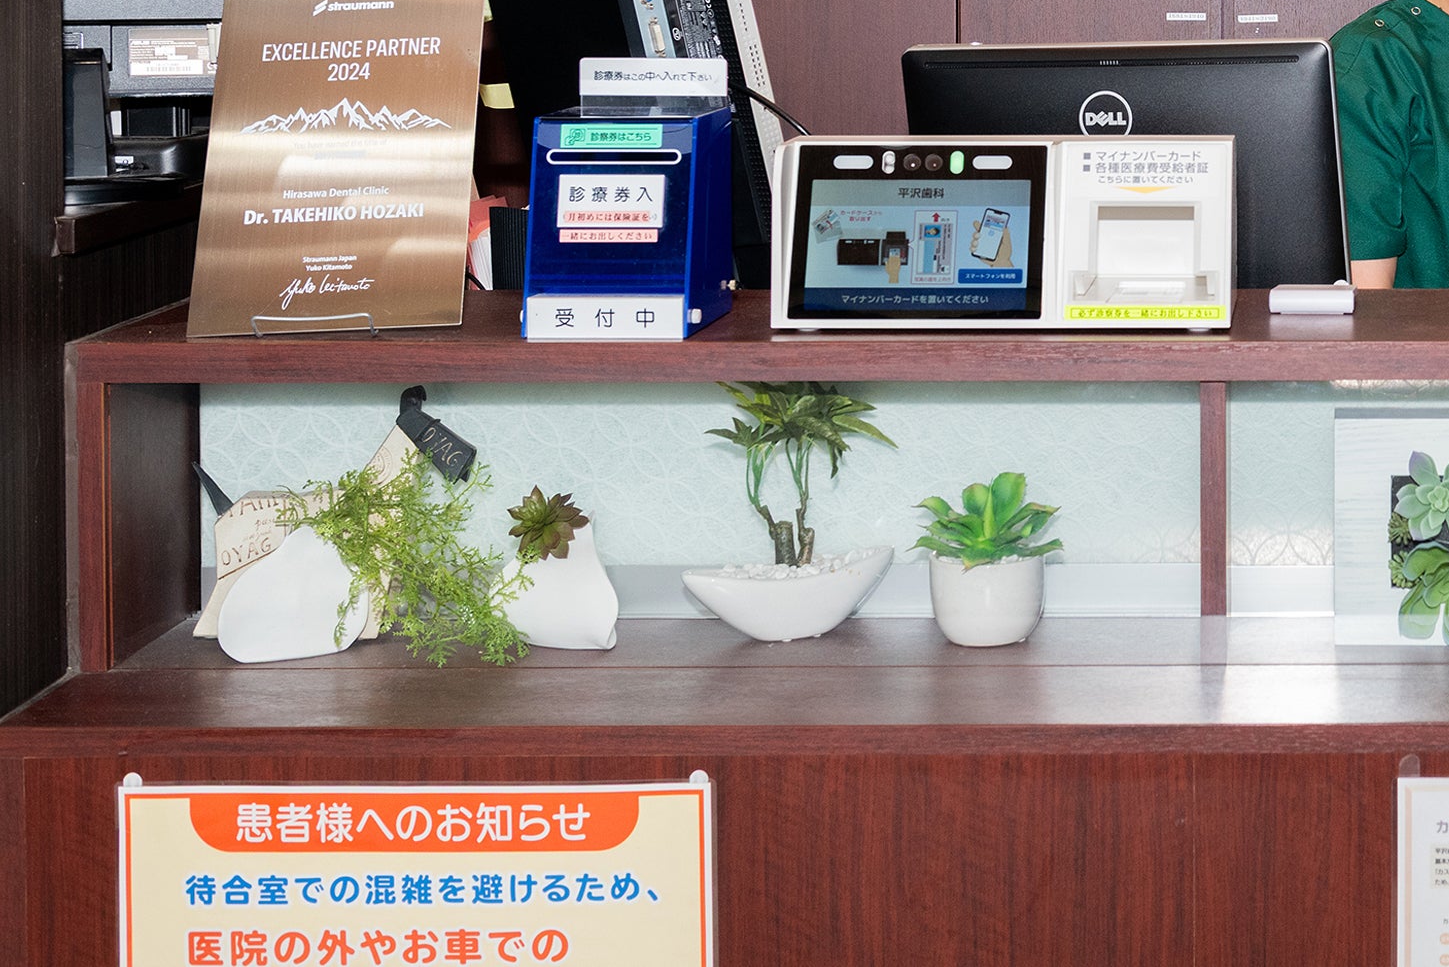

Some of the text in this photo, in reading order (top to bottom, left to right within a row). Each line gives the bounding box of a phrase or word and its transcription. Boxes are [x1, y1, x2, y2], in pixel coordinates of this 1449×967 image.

[328, 0, 394, 12] straumann
[262, 37, 441, 63] EXCELLENCE PARTNER
[327, 63, 371, 82] 2024
[594, 70, 712, 82] 診療券はこの中へ入れて下さい
[1085, 111, 1127, 127] DELL
[1096, 151, 1201, 162] マイナンバーカード
[1096, 162, 1209, 174] 各種医療費受給者証
[1098, 176, 1193, 184] こちらに置いてください
[283, 186, 390, 199] Hirasawa Dental Clinic
[569, 186, 653, 203] 診療券入
[898, 188, 945, 199] 平沢歯科
[244, 203, 425, 225] Dr. TAKEHIKO HOZAKI
[302, 254, 357, 263] Straumann Japan
[841, 295, 989, 304] マイナンバーカードを置いてください
[554, 308, 656, 328] 受付中
[235, 801, 592, 845] 患者様へのお知らせ
[185, 872, 662, 906] 待合室での混雑を避けるため、
[187, 928, 570, 966] 医院の外やお車での
